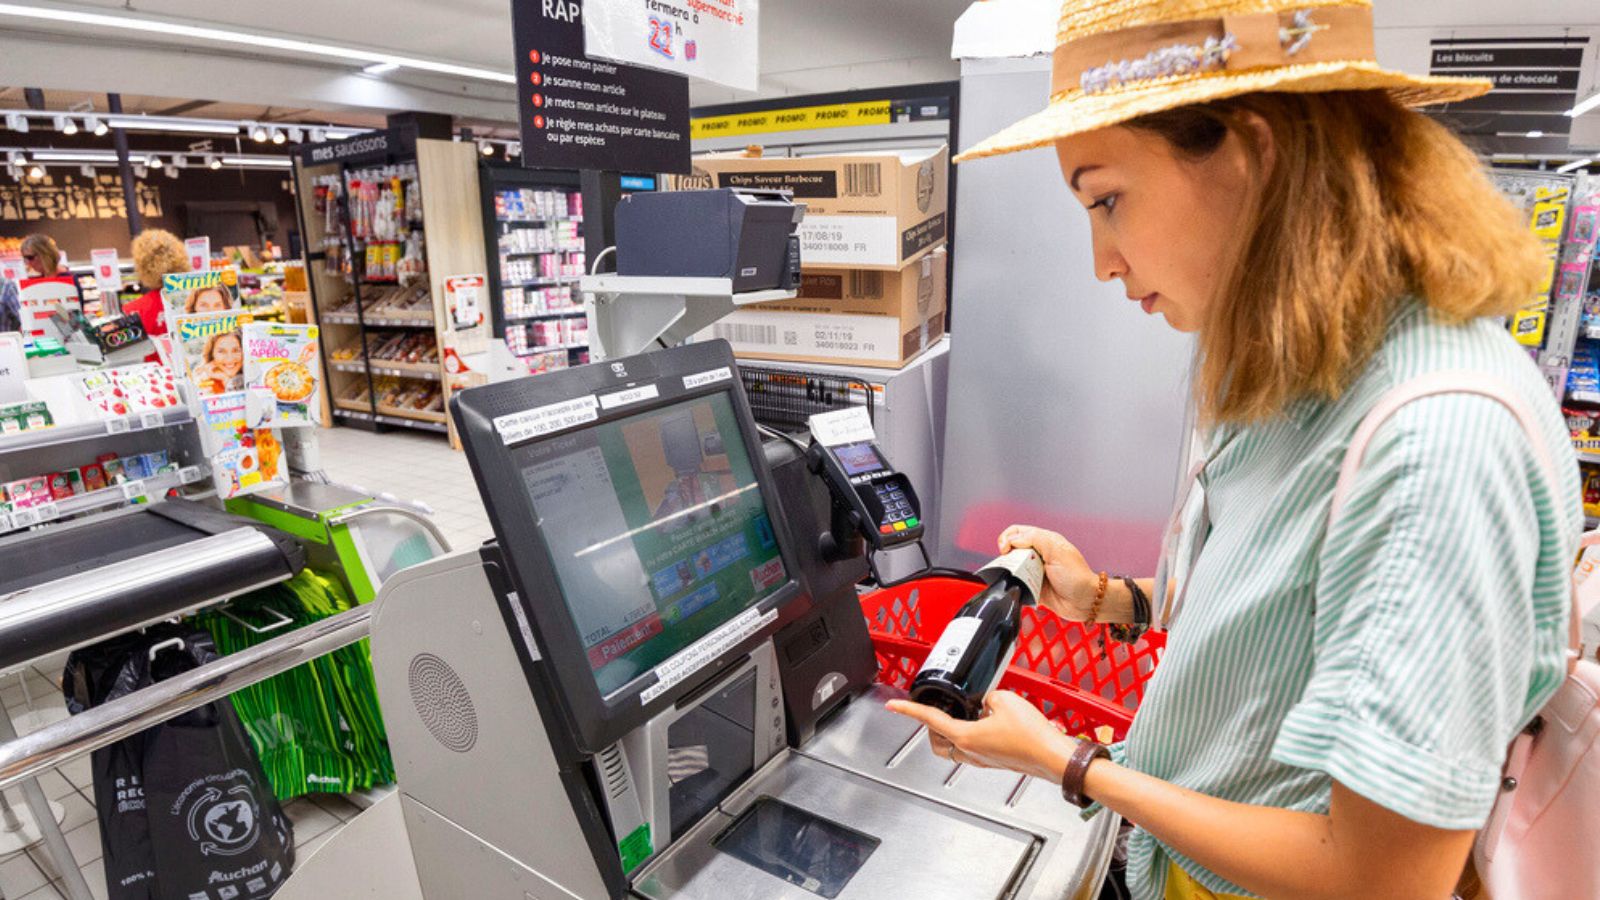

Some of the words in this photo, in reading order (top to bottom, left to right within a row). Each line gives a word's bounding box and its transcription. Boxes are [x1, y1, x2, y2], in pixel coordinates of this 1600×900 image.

[542, 0, 584, 24] RAP
[649, 17, 673, 58] 21
[542, 52, 551, 65] Je
[552, 55, 571, 67] pose
[572, 59, 591, 69] mon
[592, 63, 617, 75] panier
[1436, 53, 1453, 63] Les
[1455, 52, 1494, 63] biscuits
[543, 74, 552, 86] Je
[553, 76, 582, 90] scanne
[583, 82, 600, 91] mon
[602, 82, 625, 96] article
[1499, 75, 1512, 84] de
[1514, 75, 1558, 84] chocolat
[545, 96, 553, 108] Je
[554, 97, 575, 109] mets
[576, 101, 594, 111] mon
[596, 102, 619, 115] article
[620, 107, 632, 115] sur
[633, 106, 640, 116] le
[640, 109, 666, 121] plateau
[546, 118, 554, 129] Je
[556, 117, 576, 131] règle
[577, 122, 594, 131] mes
[595, 123, 620, 135] achats
[621, 126, 633, 136] par
[634, 126, 651, 138] carte
[652, 128, 680, 141] bancaire
[547, 133, 558, 142] ou
[560, 134, 573, 145] par
[575, 134, 605, 147] espèces
[312, 147, 333, 162] mes
[335, 136, 388, 157] saucissons
[730, 175, 752, 185] Chips
[754, 175, 782, 184] Saveur
[785, 175, 823, 183] Barbecue
[585, 625, 610, 643] TOTAL
[601, 622, 655, 660] Paiement
[208, 860, 268, 884] Auchan
